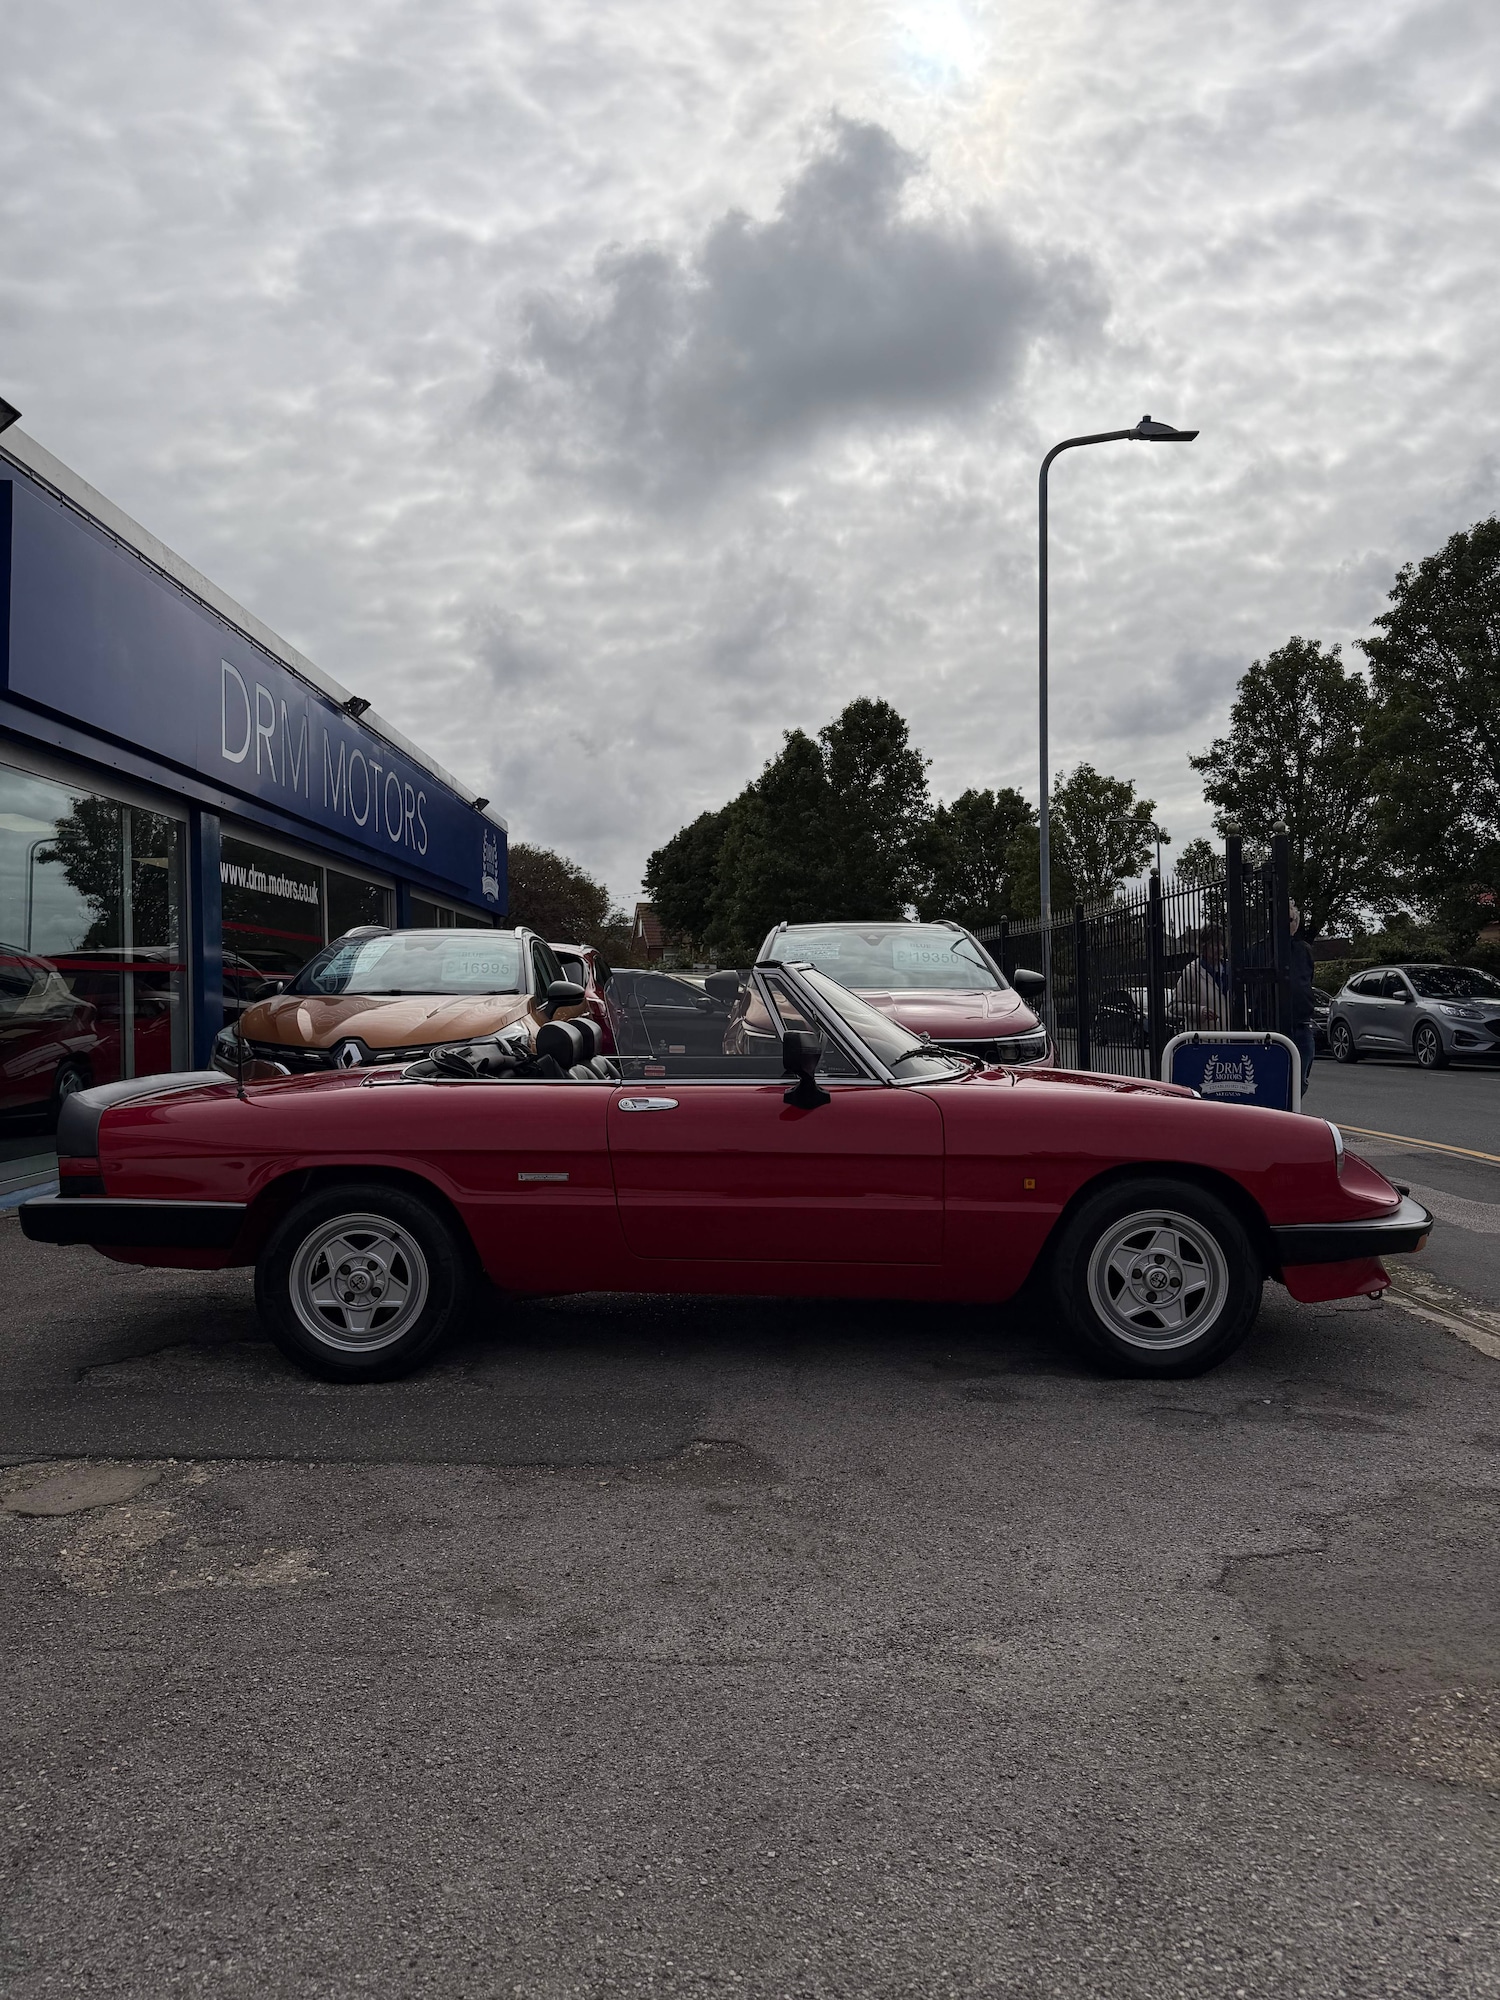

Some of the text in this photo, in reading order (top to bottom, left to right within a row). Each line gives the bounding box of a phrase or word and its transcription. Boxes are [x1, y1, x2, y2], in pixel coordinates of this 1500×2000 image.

[222, 658, 428, 855] DRM MOTORS
[1215, 1062, 1243, 1074] DRM
